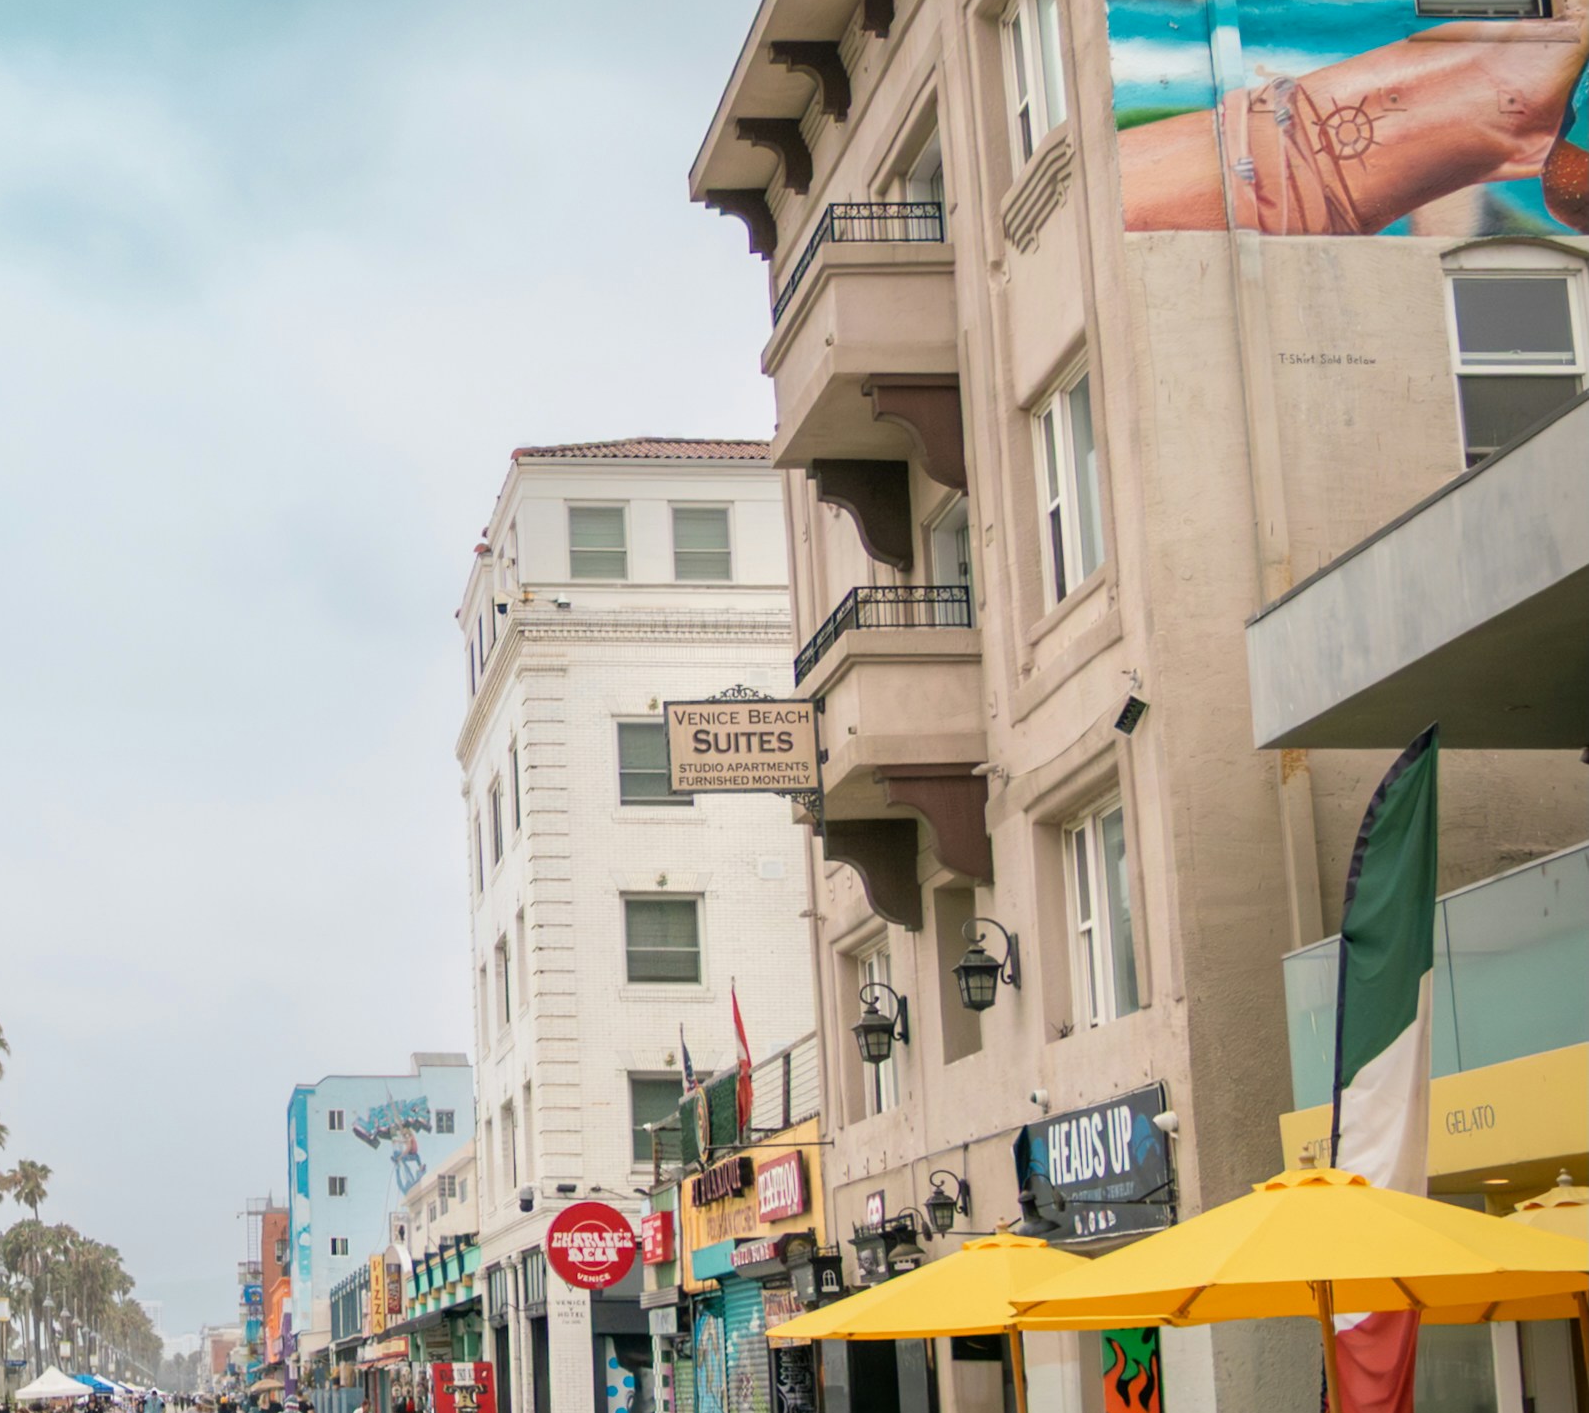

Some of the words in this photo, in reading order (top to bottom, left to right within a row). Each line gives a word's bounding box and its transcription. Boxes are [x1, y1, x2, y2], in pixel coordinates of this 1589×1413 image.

[1320, 353, 1342, 364] Sold
[1346, 354, 1376, 365] Below
[674, 710, 740, 725] VENICE
[749, 709, 810, 724] BEACH
[693, 729, 794, 754] SUITES
[679, 763, 724, 773] STUDIO
[727, 762, 809, 772] APARTMENTS
[679, 776, 749, 786] FURNISHED
[753, 774, 810, 785] MONTHLY
[1446, 1105, 1495, 1135] GELATO
[1048, 1112, 1105, 1186] HEADS
[1107, 1105, 1132, 1174] UP
[758, 1160, 799, 1214] TATTOO
[568, 1247, 619, 1262] DELI
[577, 1272, 612, 1282] VENICE
[373, 1260, 383, 1330] PIZZA
